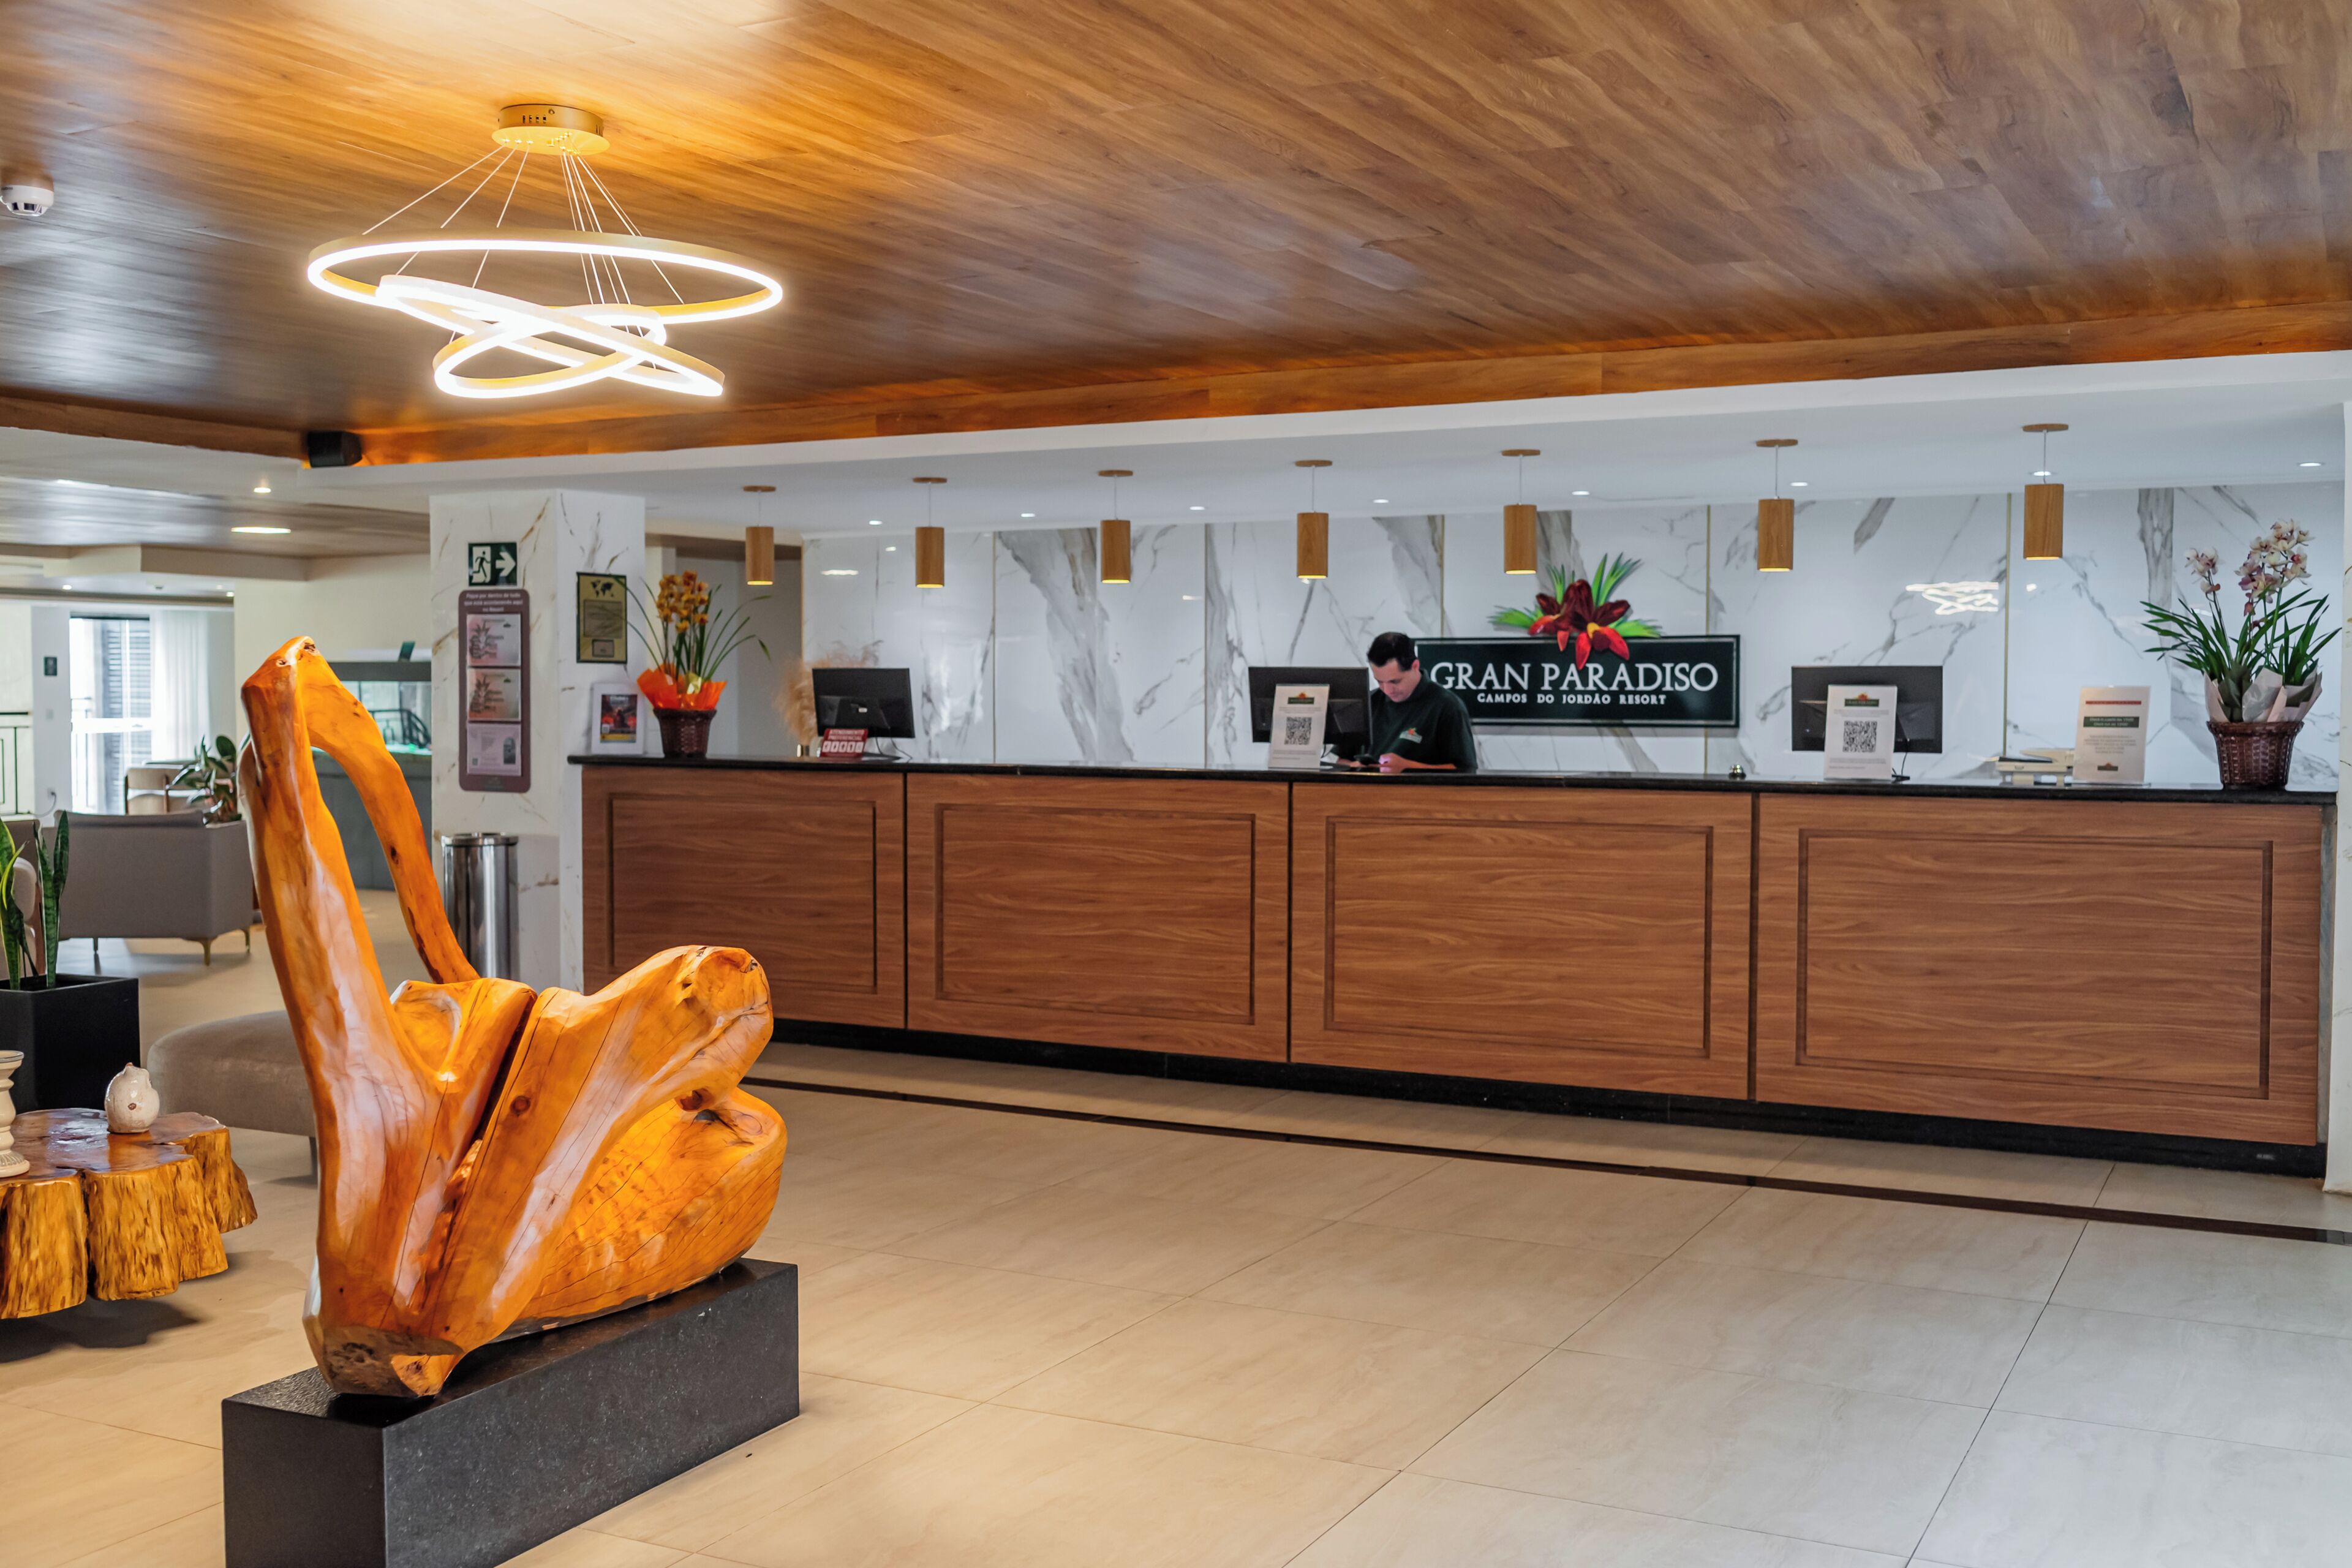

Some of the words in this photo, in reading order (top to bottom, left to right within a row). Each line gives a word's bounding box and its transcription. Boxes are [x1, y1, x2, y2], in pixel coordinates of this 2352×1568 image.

[1430, 662, 1531, 690] GRAN
[1540, 662, 1718, 692] PARADISO
[1477, 693, 1528, 703] CAMPOS
[1537, 694, 1555, 704] DO
[1562, 693, 1611, 704] JORDÃO
[1619, 694, 1667, 704] RESORT
